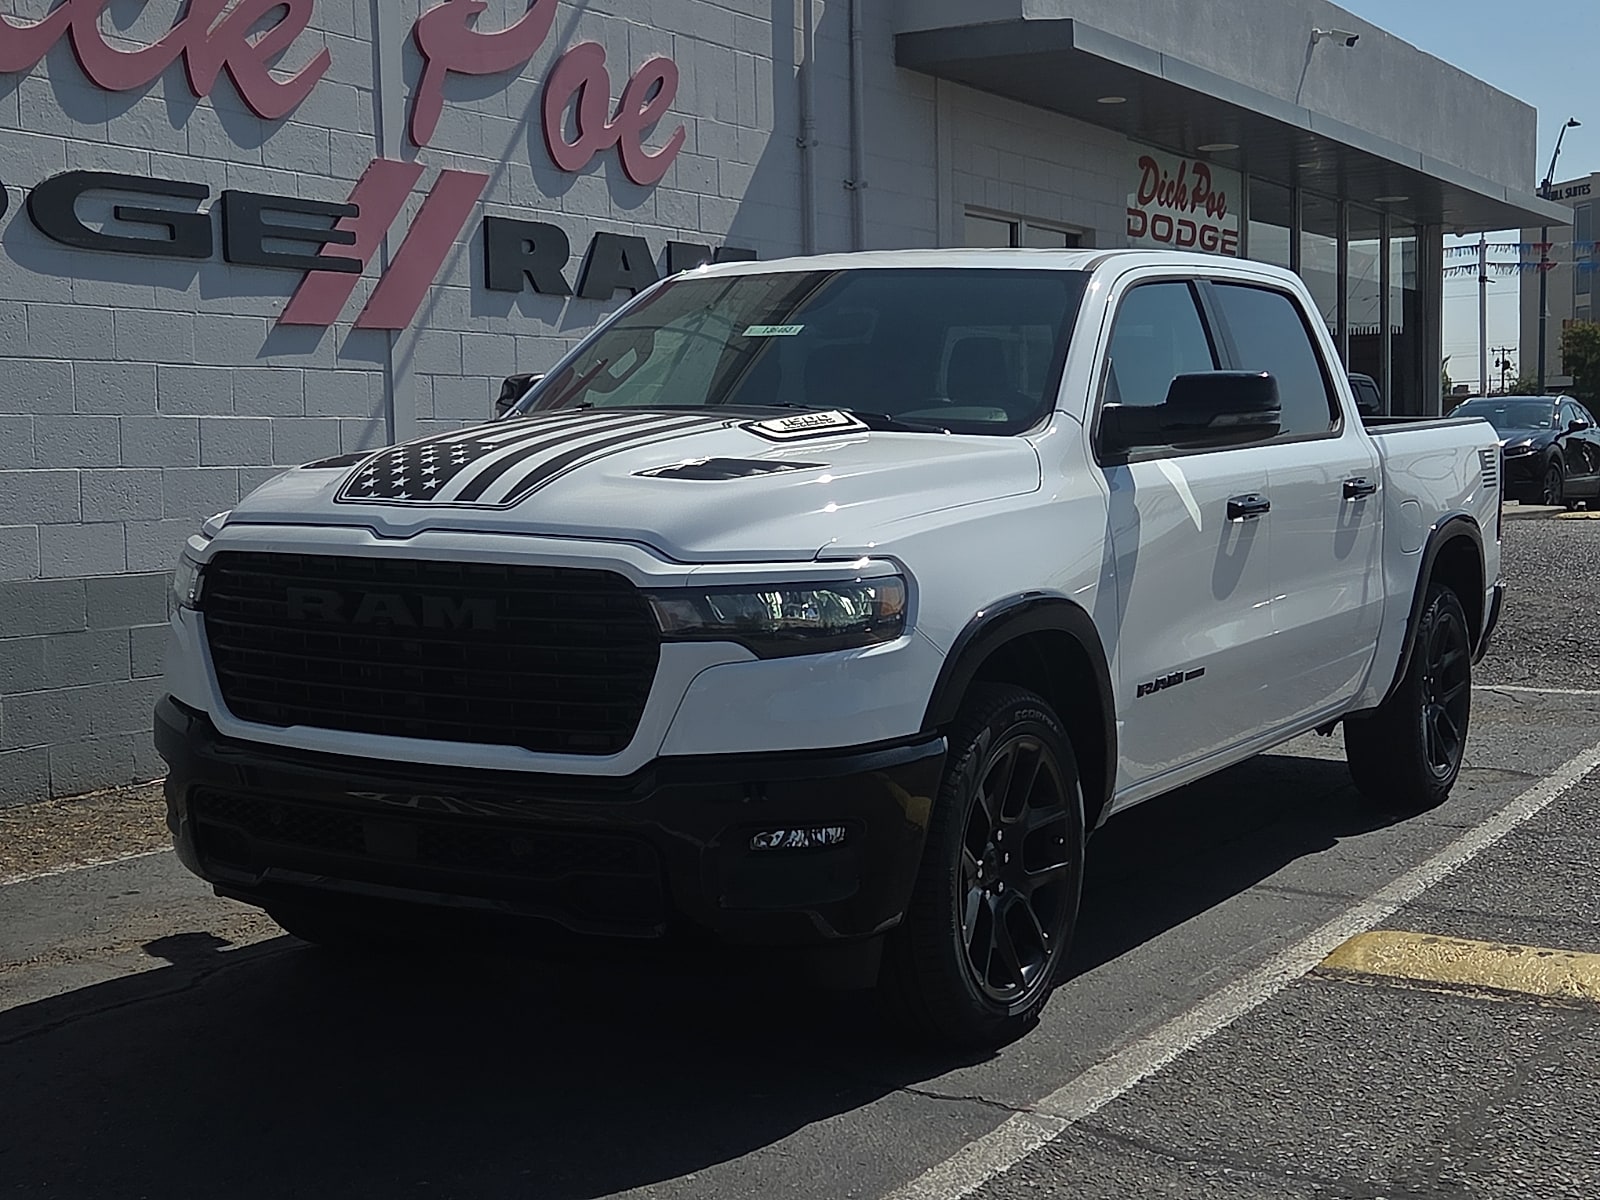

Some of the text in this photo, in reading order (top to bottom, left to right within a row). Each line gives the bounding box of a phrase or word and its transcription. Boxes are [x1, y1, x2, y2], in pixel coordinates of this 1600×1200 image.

[409, 0, 685, 186] Poe
[1137, 155, 1227, 220] Dick Poe
[1565, 184, 1592, 199] SUITES
[0, 170, 362, 273] GE
[1126, 207, 1239, 256] DODGE
[287, 587, 496, 631] RAM
[1136, 671, 1184, 698] RAM
